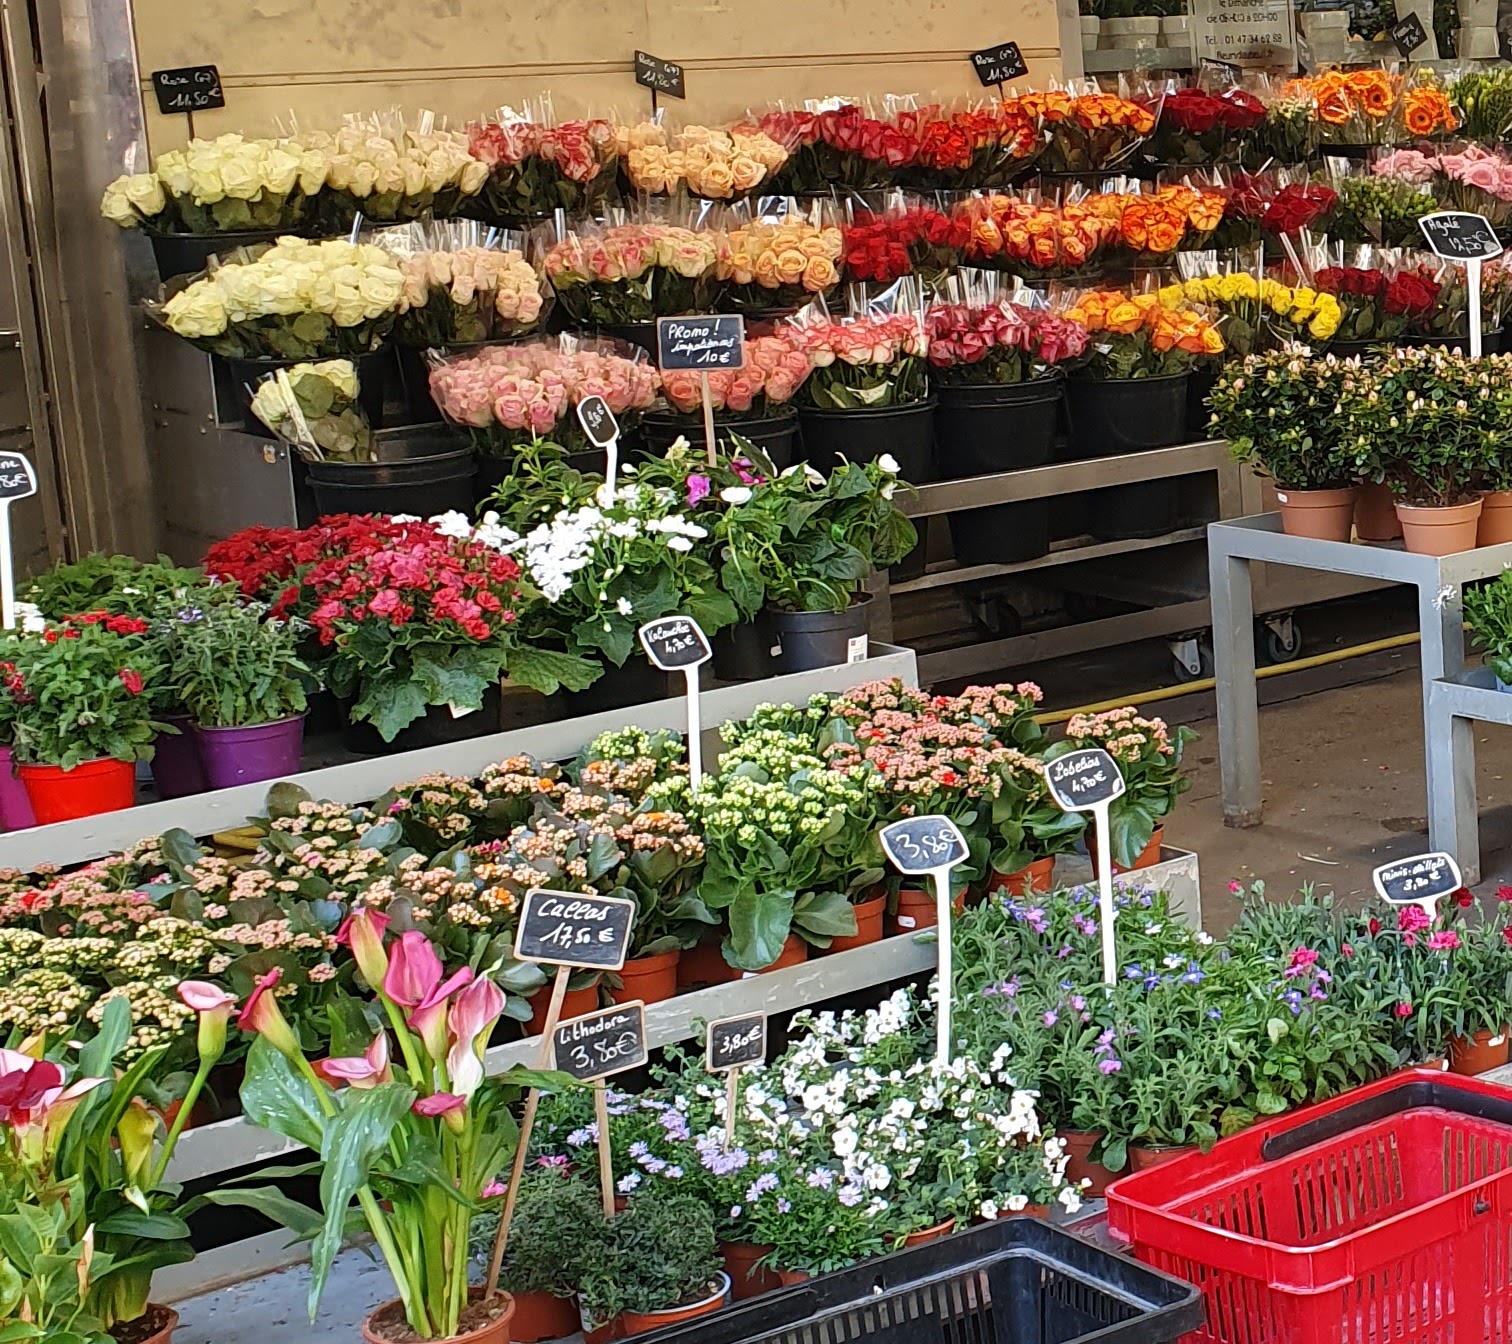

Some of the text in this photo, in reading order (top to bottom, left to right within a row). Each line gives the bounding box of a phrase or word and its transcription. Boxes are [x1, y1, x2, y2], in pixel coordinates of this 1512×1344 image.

[895, 827, 958, 859] 3,80€
[537, 898, 612, 921] Callas
[570, 1031, 638, 1069] 3,80€
[719, 1024, 763, 1054] 3,80€
